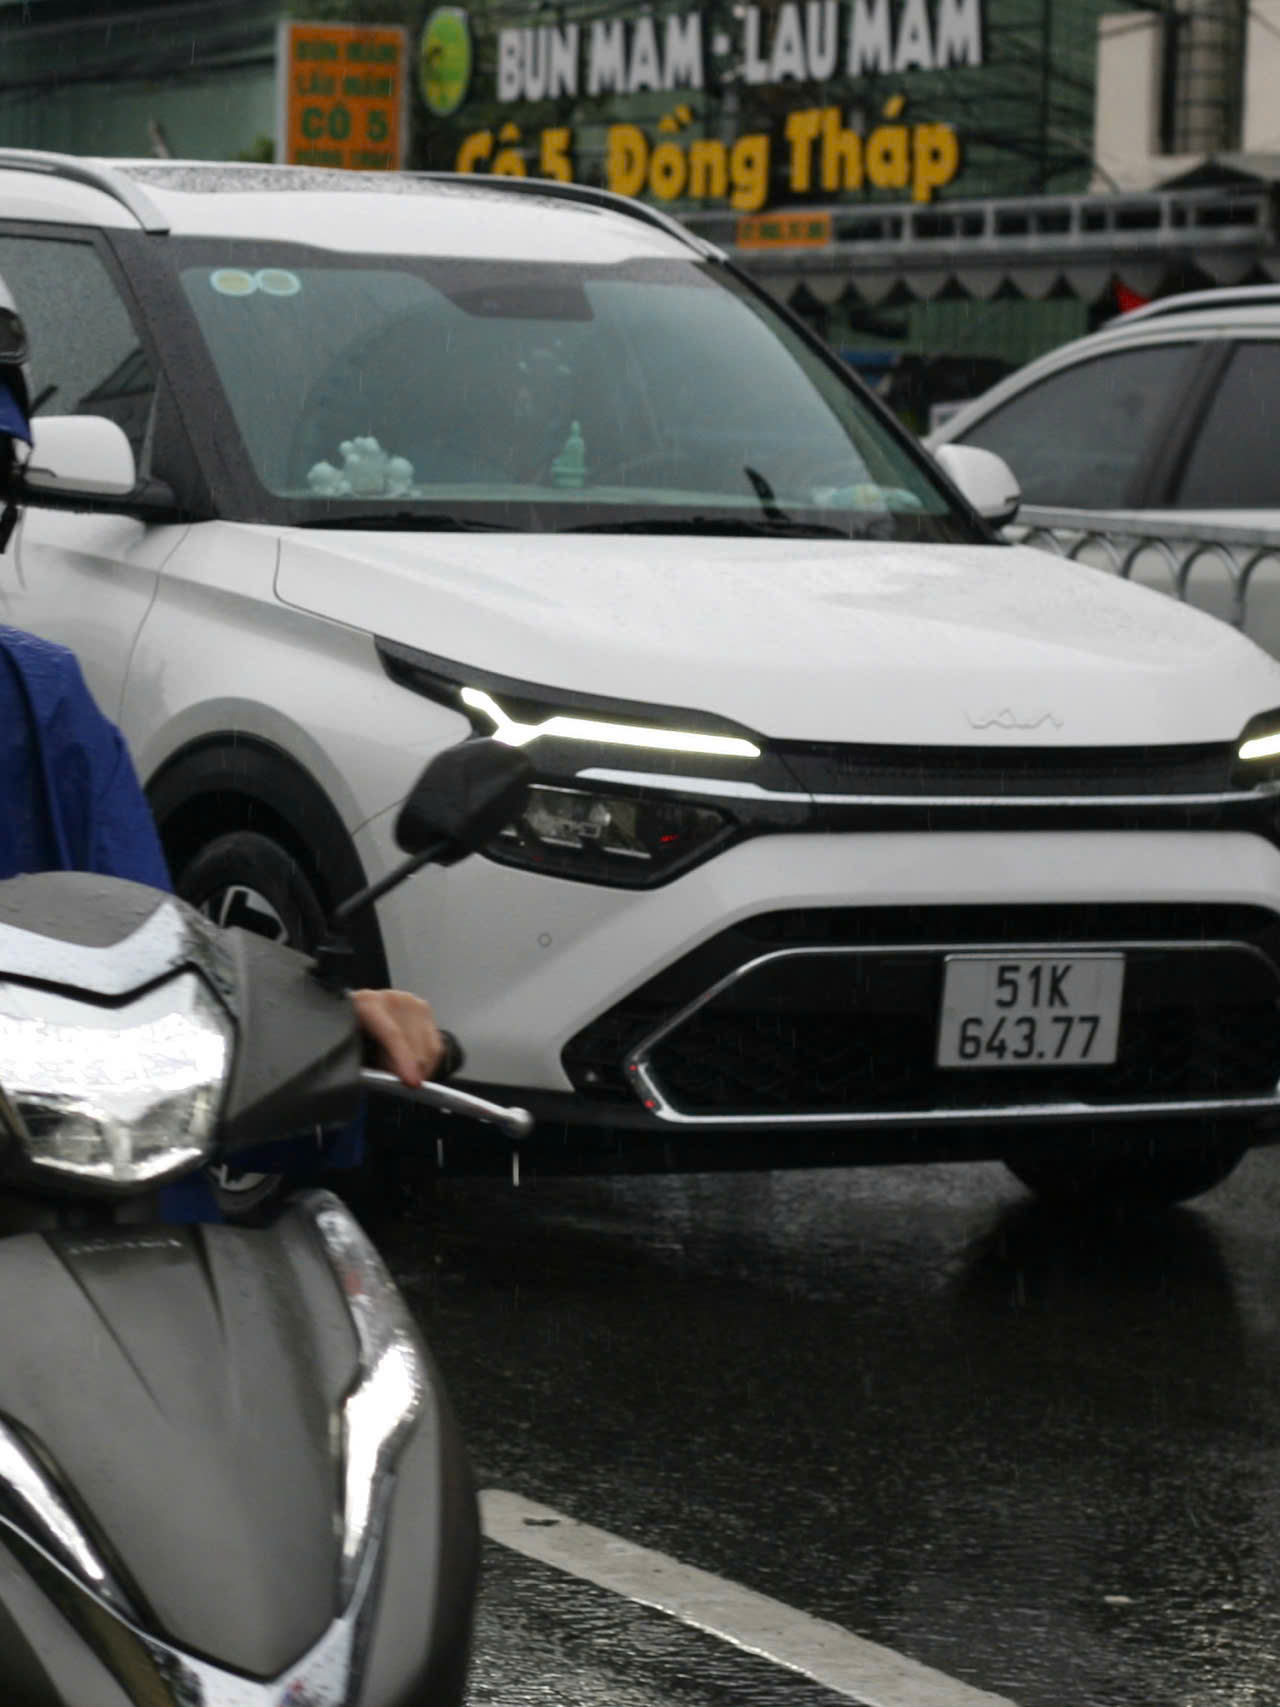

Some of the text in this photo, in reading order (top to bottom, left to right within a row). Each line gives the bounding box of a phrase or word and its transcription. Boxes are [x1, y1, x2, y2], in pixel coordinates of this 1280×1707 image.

[301, 101, 389, 142] CÔ 5
[541, 127, 572, 184] 5
[784, 95, 958, 203] Tháp
[995, 964, 1072, 1009] 51K
[958, 1015, 1100, 1061] 643.77
